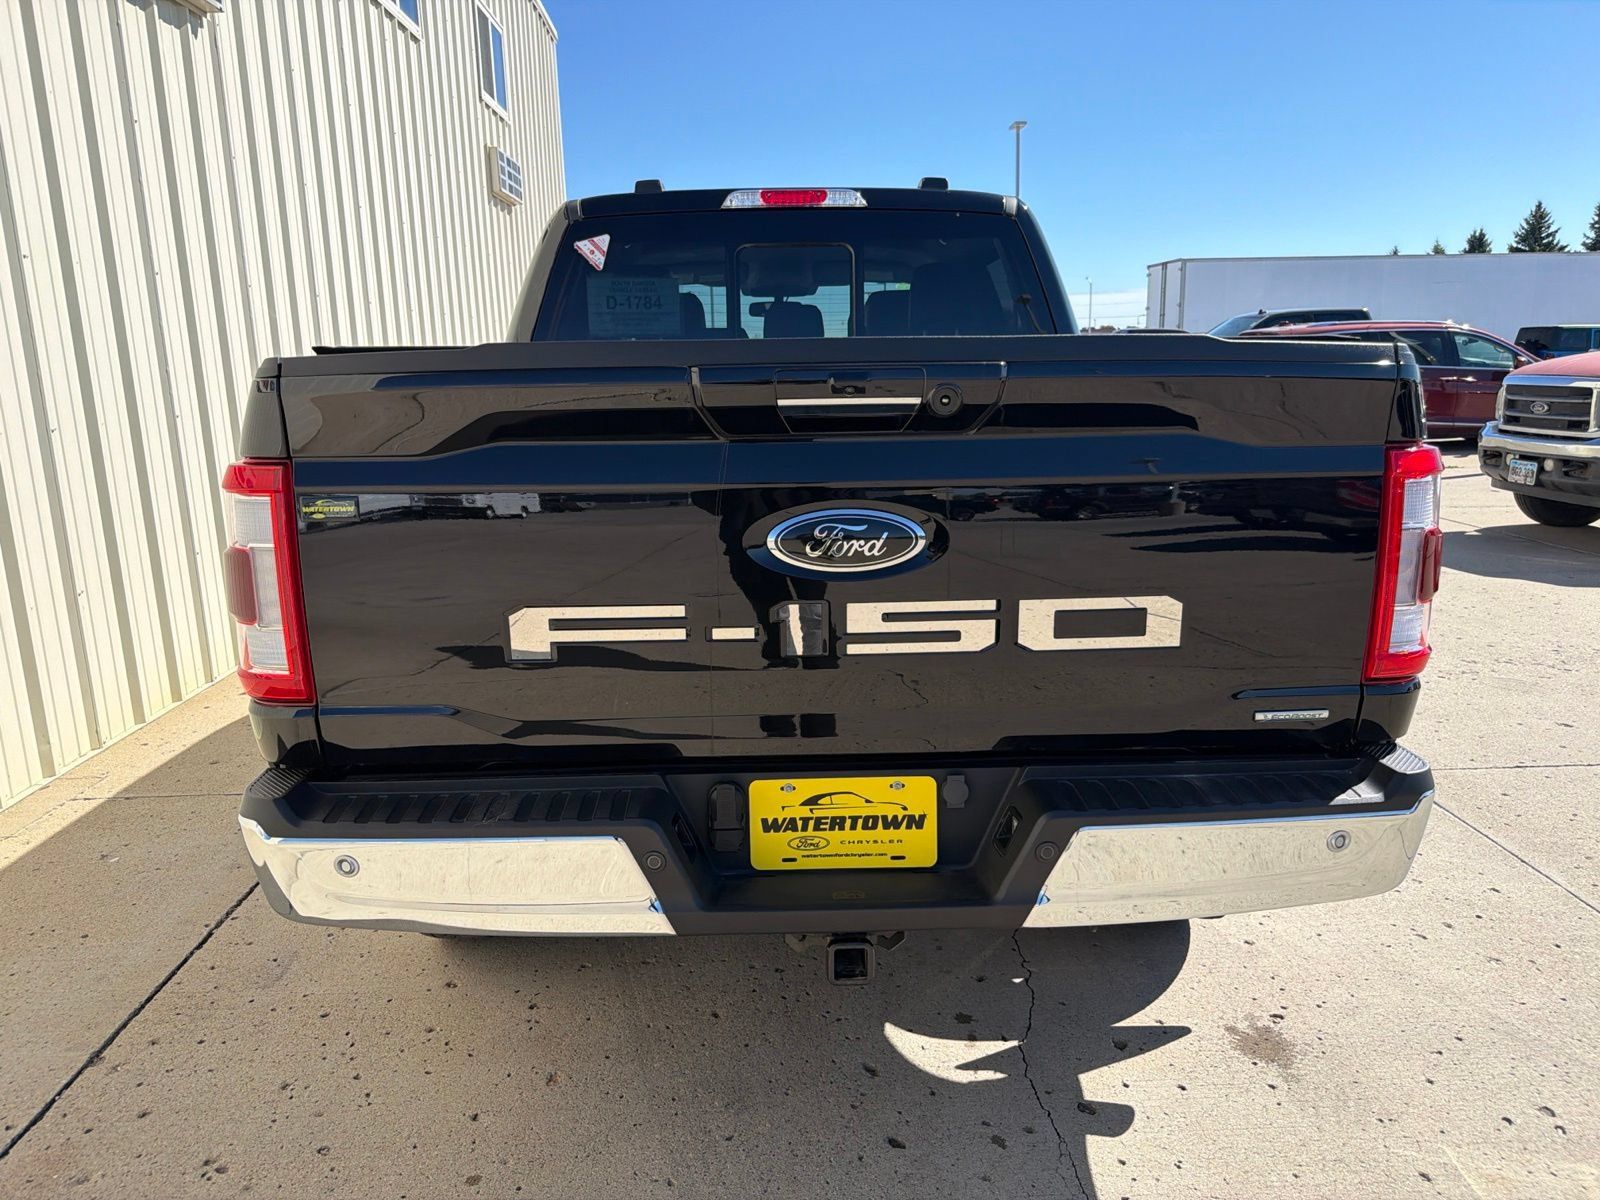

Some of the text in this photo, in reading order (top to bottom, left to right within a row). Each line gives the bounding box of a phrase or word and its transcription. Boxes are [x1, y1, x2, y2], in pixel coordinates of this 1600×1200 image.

[606, 295, 664, 310] D-1784
[805, 523, 889, 558] Ford
[507, 596, 1184, 661] F-150
[760, 814, 927, 833] WATERTOWN
[796, 837, 821, 849] Ford
